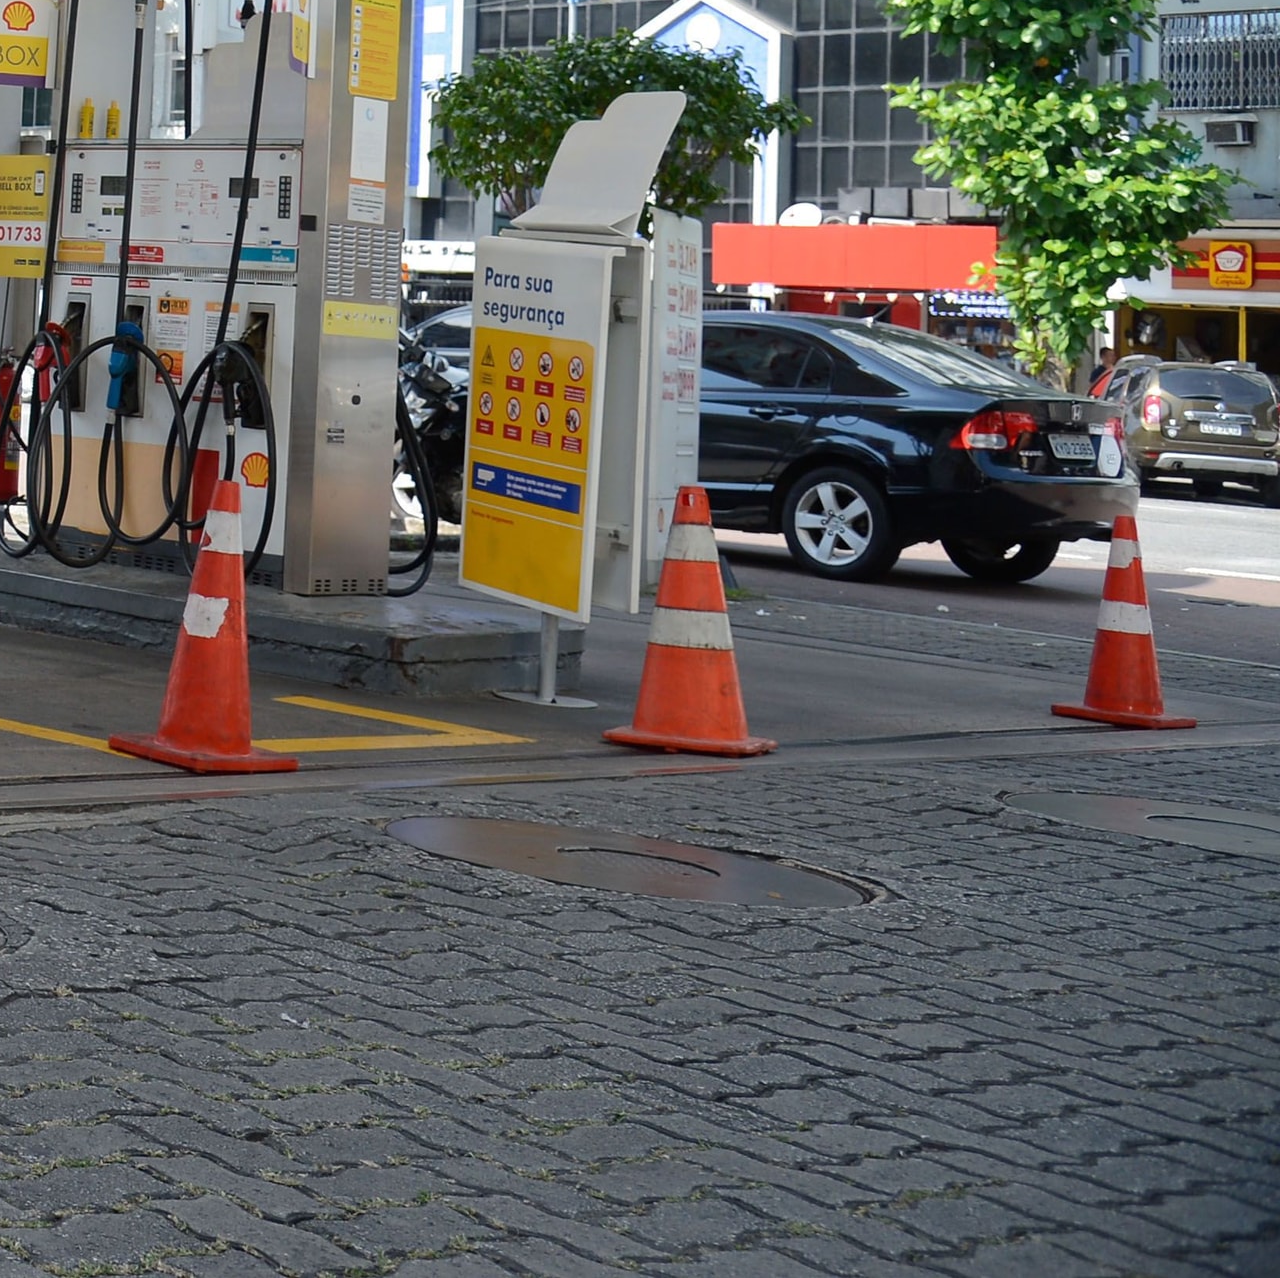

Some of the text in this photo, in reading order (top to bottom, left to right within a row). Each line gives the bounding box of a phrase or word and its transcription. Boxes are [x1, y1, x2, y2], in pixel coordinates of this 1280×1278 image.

[15, 182, 32, 191] BOX
[485, 267, 553, 293] Para sua
[171, 300, 188, 311] anp
[483, 301, 565, 330] segurança
